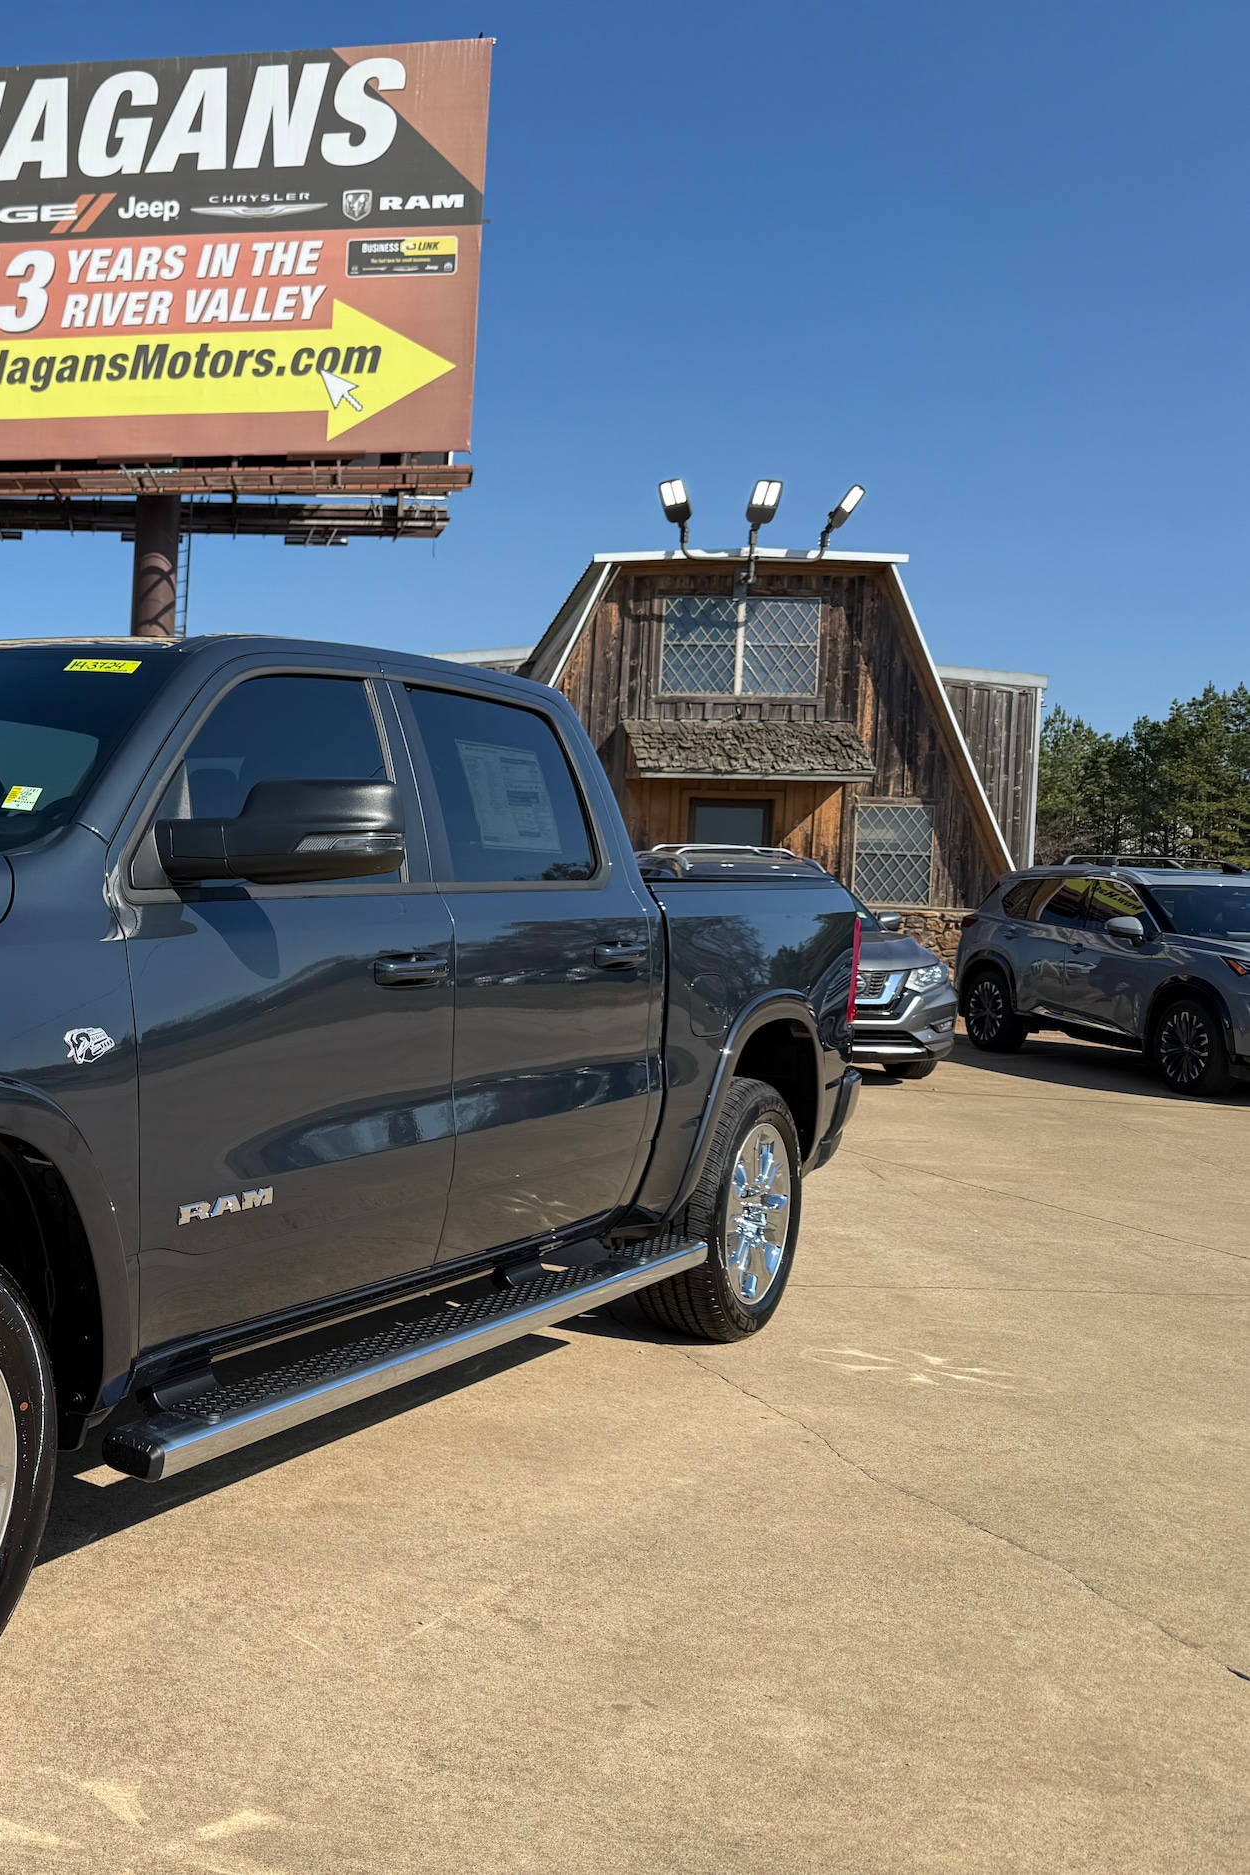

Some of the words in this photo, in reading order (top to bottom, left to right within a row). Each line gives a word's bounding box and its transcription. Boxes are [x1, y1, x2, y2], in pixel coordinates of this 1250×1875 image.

[117, 196, 181, 222] Jeep
[208, 192, 311, 204] CHRYSLER
[379, 194, 465, 211] RAM
[361, 243, 399, 254] BUSINESS
[418, 241, 440, 251] LINK
[67, 243, 187, 285] YEARS
[196, 242, 244, 281] IN
[250, 239, 325, 278] THE
[60, 289, 172, 329] RIVER
[184, 285, 327, 325] VALLEY
[177, 1185, 274, 1226] RAM
